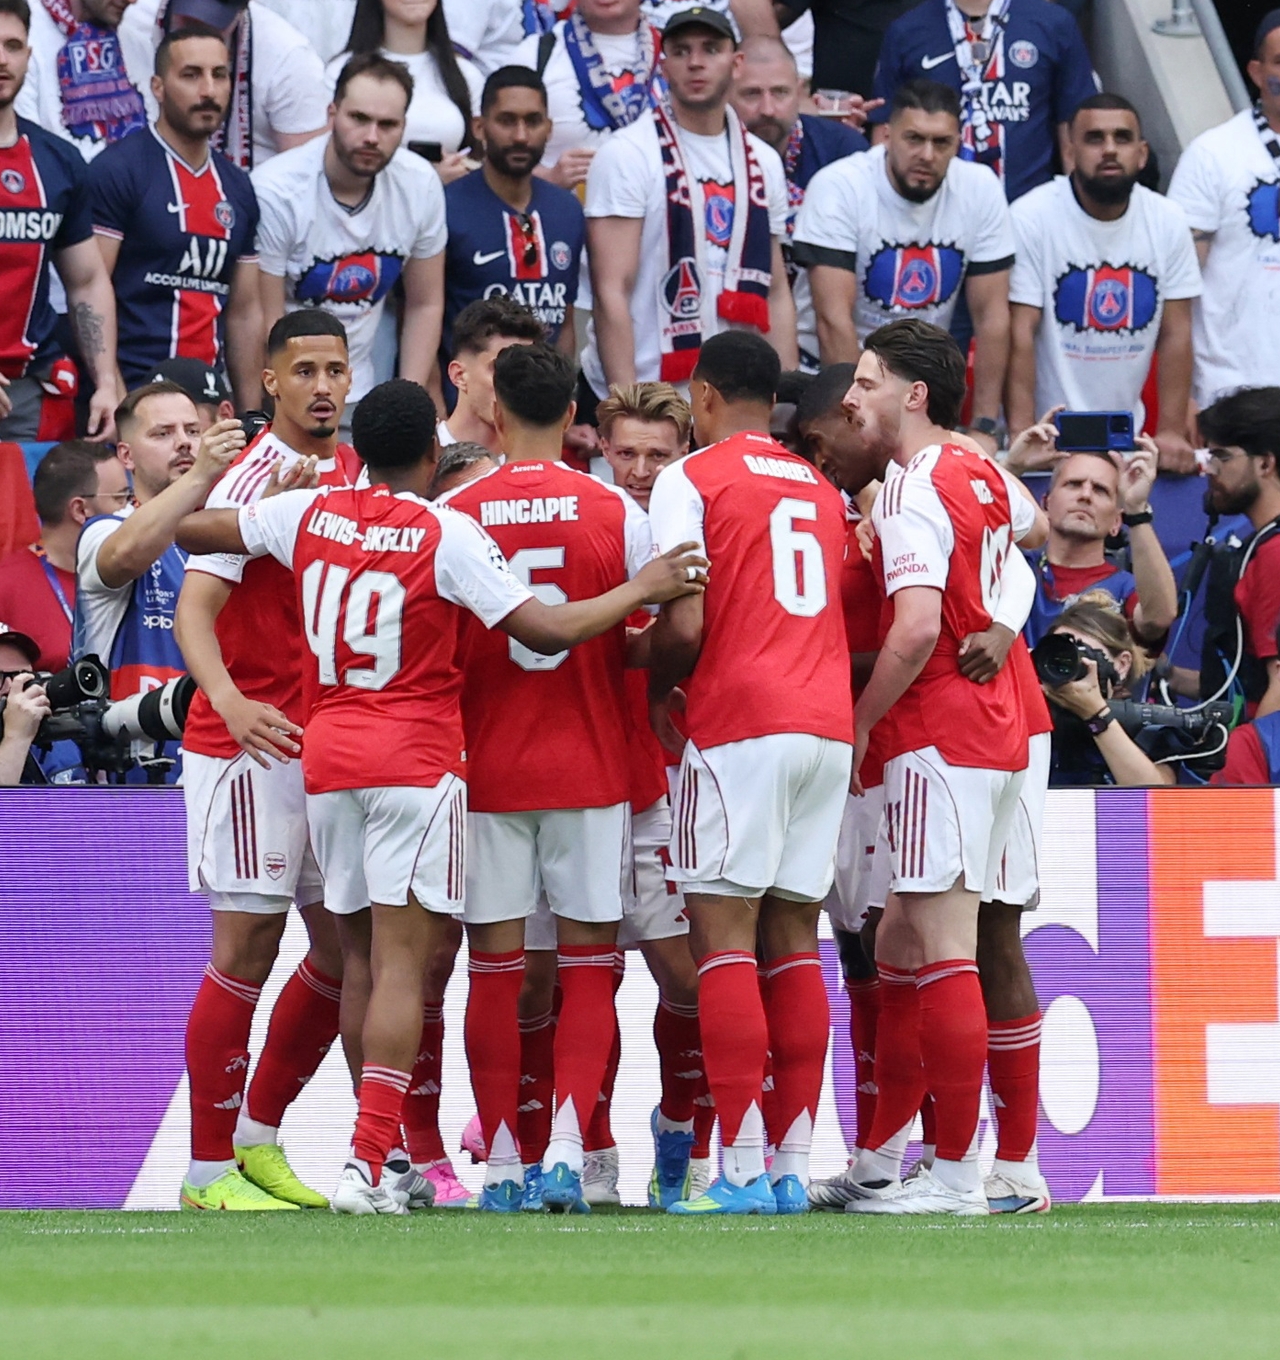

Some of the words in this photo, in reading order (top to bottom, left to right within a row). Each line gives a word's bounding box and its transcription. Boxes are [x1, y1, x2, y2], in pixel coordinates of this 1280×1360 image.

[72, 41, 115, 74] PSG
[979, 81, 1031, 106] TAR
[986, 105, 1030, 122] WAYS
[177, 235, 228, 278] All
[743, 454, 819, 486] GABRIEL
[480, 496, 579, 527] HINCAPIE
[769, 496, 828, 618] 6
[886, 562, 930, 584] RWANDA
[892, 552, 917, 567] VISIT
[302, 558, 407, 691] 49
[507, 545, 571, 672] 5
